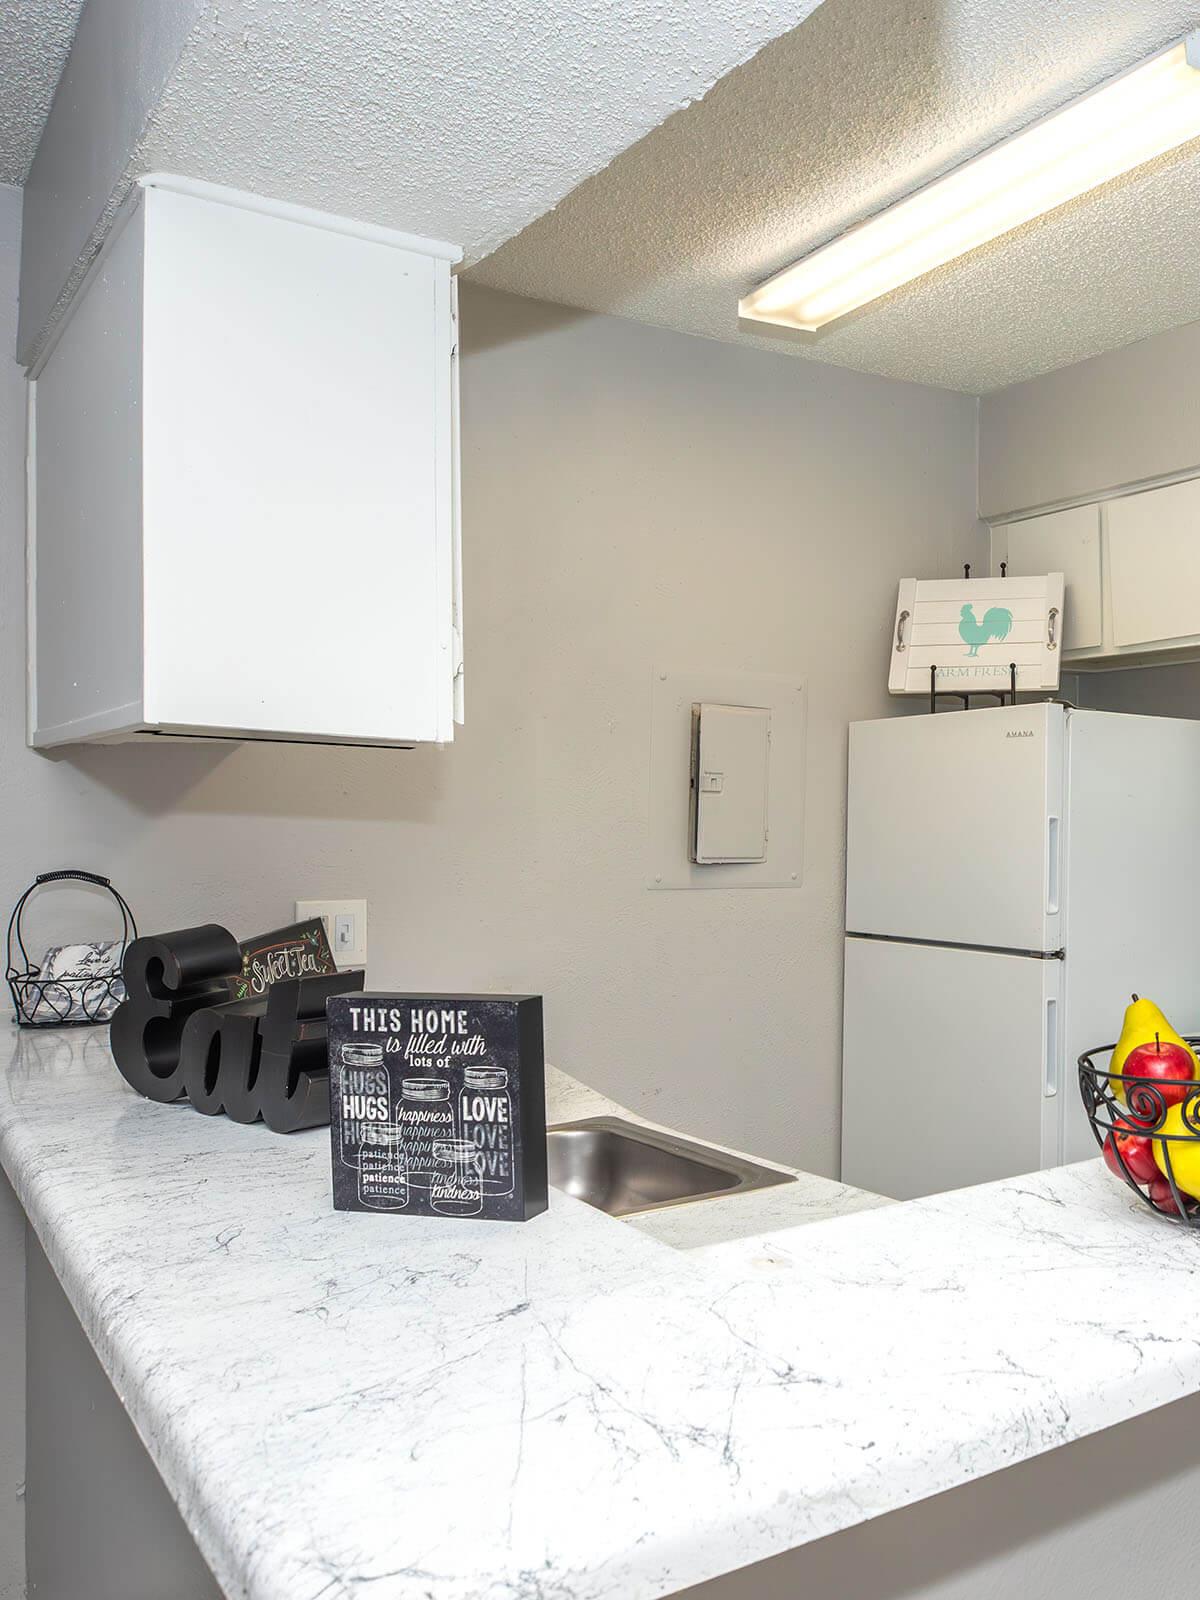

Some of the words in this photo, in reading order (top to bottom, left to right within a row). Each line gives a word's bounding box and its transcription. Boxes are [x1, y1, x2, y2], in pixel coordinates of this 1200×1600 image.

[937, 667, 969, 678] ARM
[1005, 730, 1034, 738] AMANA
[251, 947, 295, 993] Sweet
[289, 944, 321, 977] Tea
[350, 1007, 401, 1032] THIS
[411, 1009, 468, 1034] HOME
[110, 934, 330, 1134] Eat
[386, 1036, 402, 1053] is
[404, 1034, 447, 1060] filled
[451, 1034, 487, 1056] with
[409, 1054, 432, 1067] lots
[436, 1056, 451, 1068] of
[342, 1071, 387, 1095] HUGS
[343, 1095, 388, 1121] HUGS
[398, 1107, 453, 1126] happiness
[463, 1096, 508, 1123] LOVE
[400, 1122, 453, 1141] happiness
[463, 1123, 509, 1149] LOVE
[362, 1149, 405, 1160] patience
[464, 1150, 510, 1177] LOVE
[362, 1162, 405, 1173] patience
[362, 1173, 406, 1184] patience
[363, 1184, 407, 1196] patience
[431, 1184, 480, 1200] kindness
